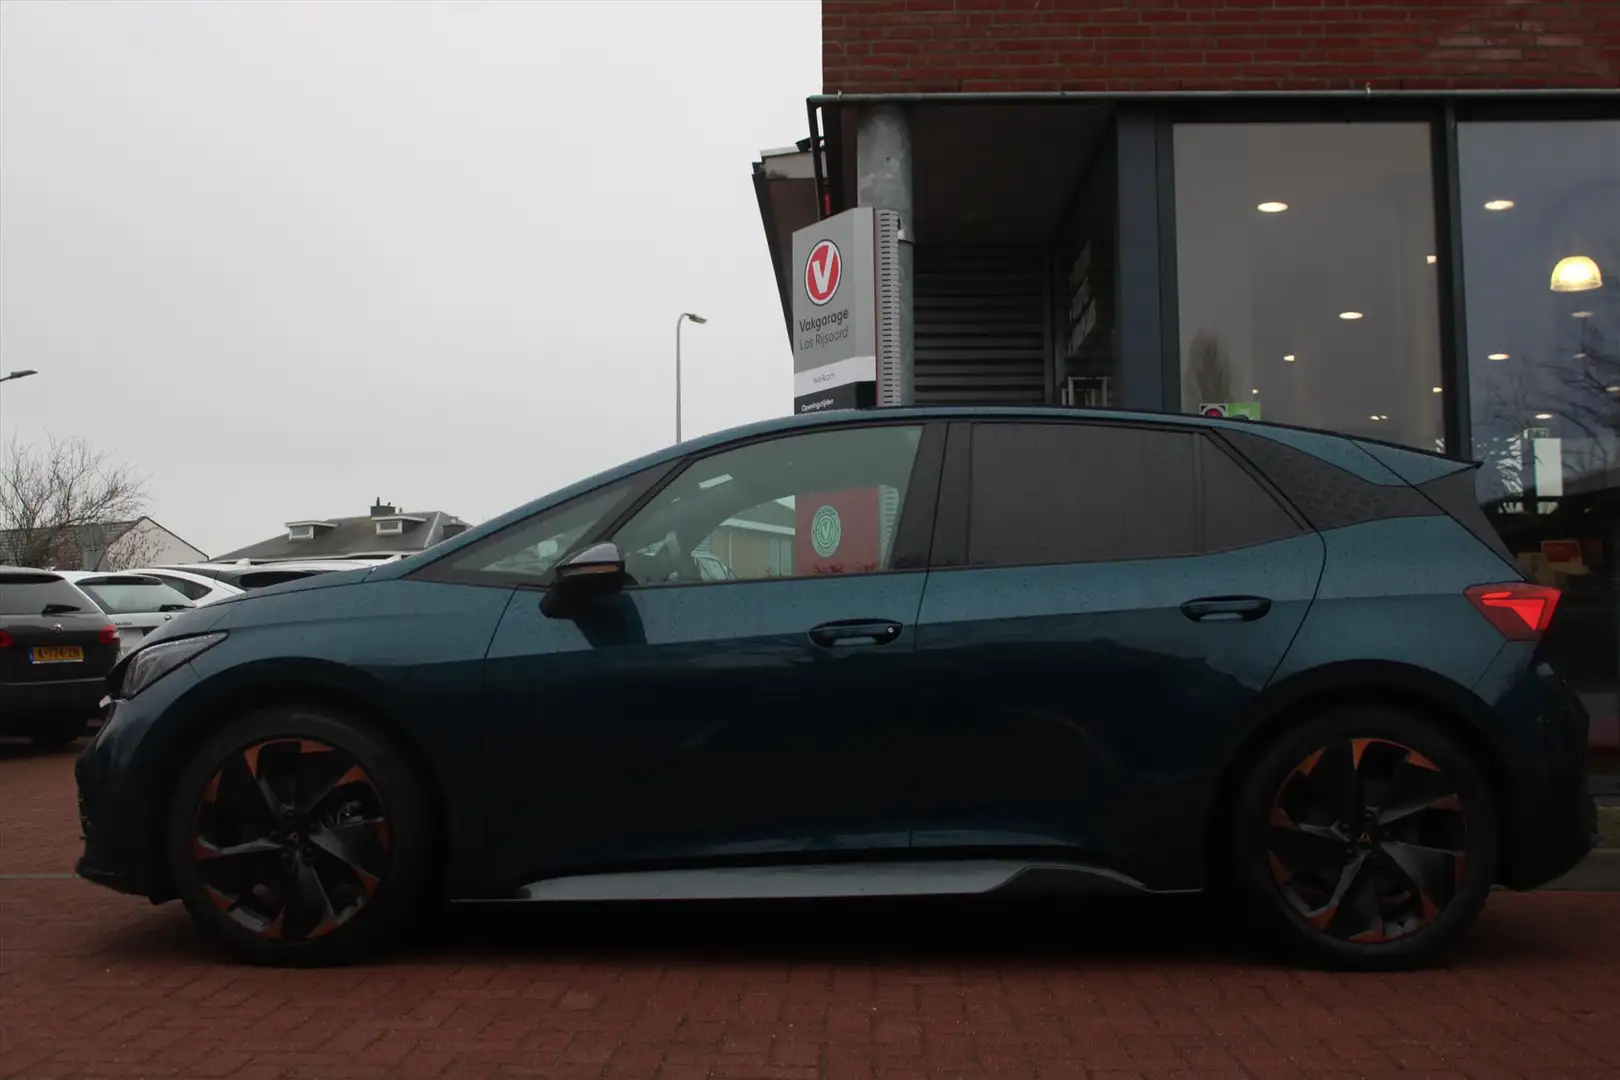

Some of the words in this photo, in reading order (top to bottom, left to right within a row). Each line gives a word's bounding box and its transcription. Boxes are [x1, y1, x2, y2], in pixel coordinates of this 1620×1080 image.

[811, 243, 835, 294] V
[799, 308, 849, 332] Vakgarage
[815, 325, 849, 348] Rijsoord
[801, 397, 834, 411] Openingstijden
